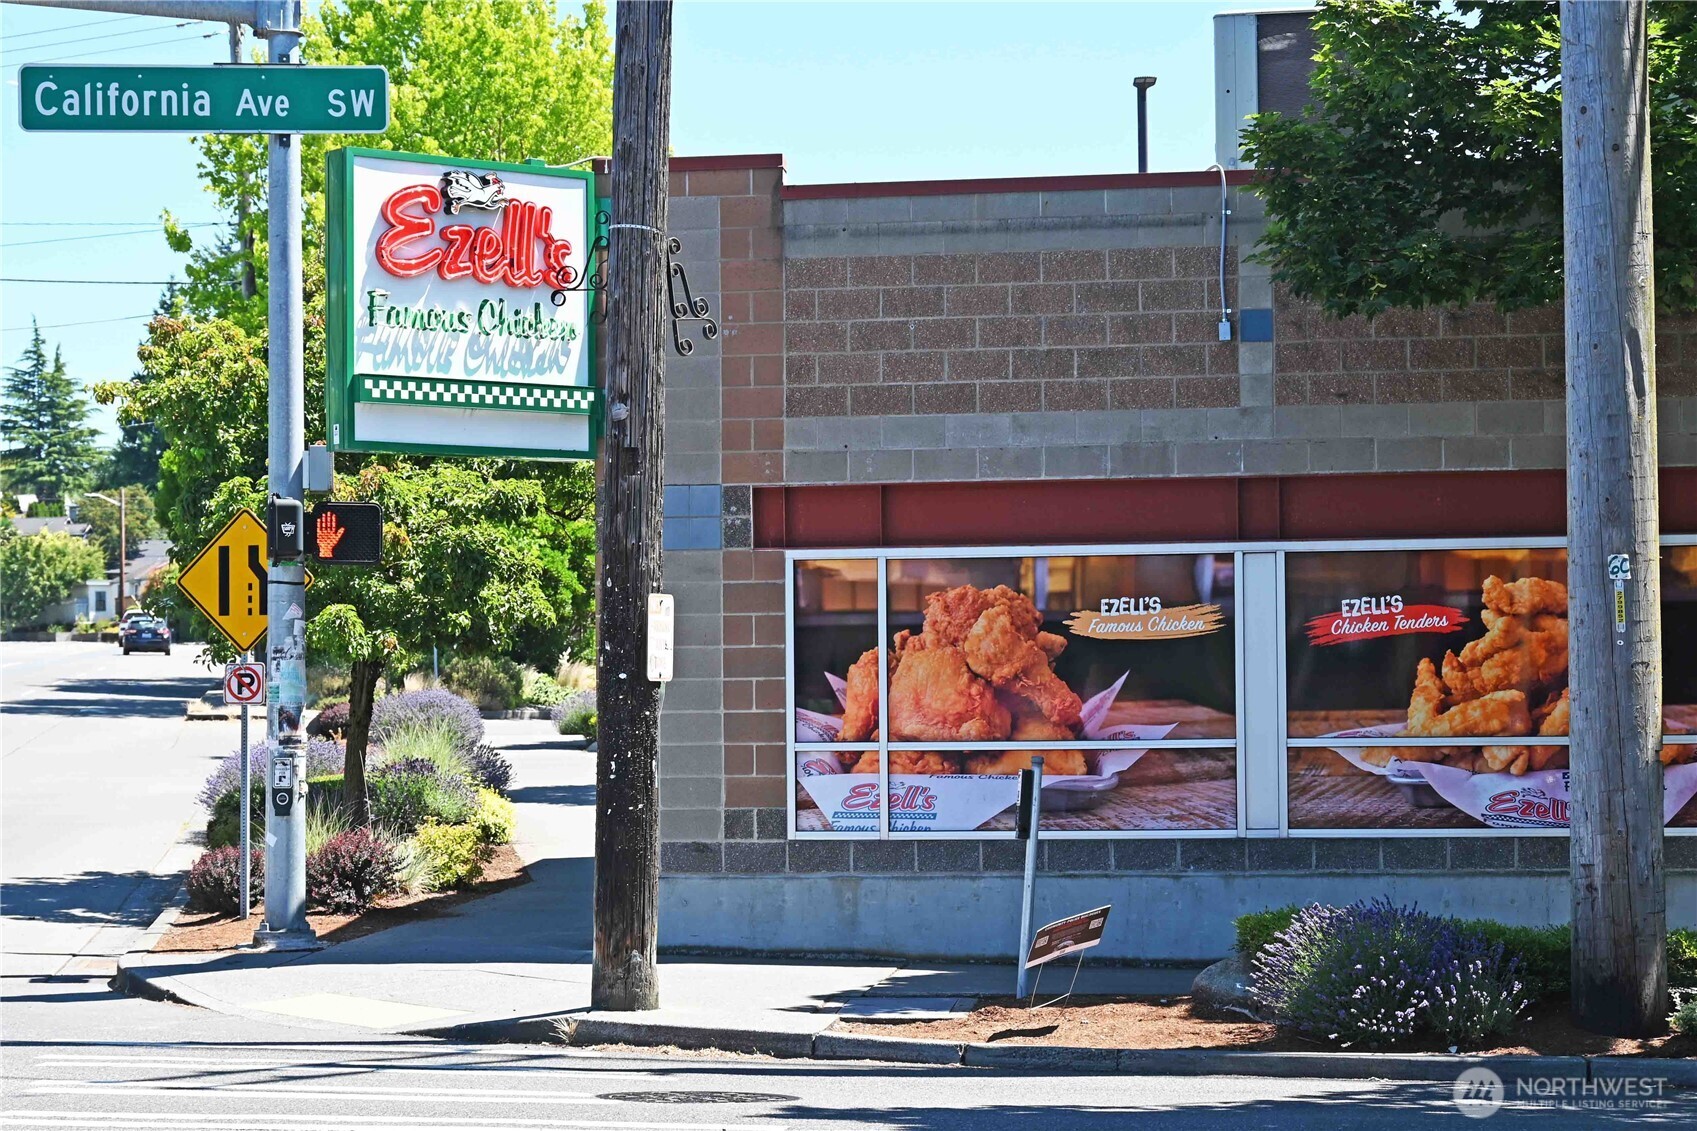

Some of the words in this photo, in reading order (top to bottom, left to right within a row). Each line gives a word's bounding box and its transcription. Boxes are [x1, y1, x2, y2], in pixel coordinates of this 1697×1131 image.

[34, 81, 211, 116] California
[235, 88, 290, 117] Ave
[327, 89, 375, 117] SW
[375, 183, 573, 290] Ezell's
[366, 288, 473, 334] Famous
[477, 297, 579, 342] Chicken
[1100, 596, 1162, 617] EZELL'S
[1341, 595, 1405, 618] EZELL'S
[1088, 618, 1144, 633] Famous
[1147, 615, 1206, 632] Chicken
[1331, 617, 1390, 635] Chicken
[1394, 613, 1449, 630] Tenders
[977, 773, 1019, 781] Chicke
[841, 782, 937, 811] Ezell's
[1484, 789, 1571, 822] Ezell
[888, 820, 932, 831] hicken
